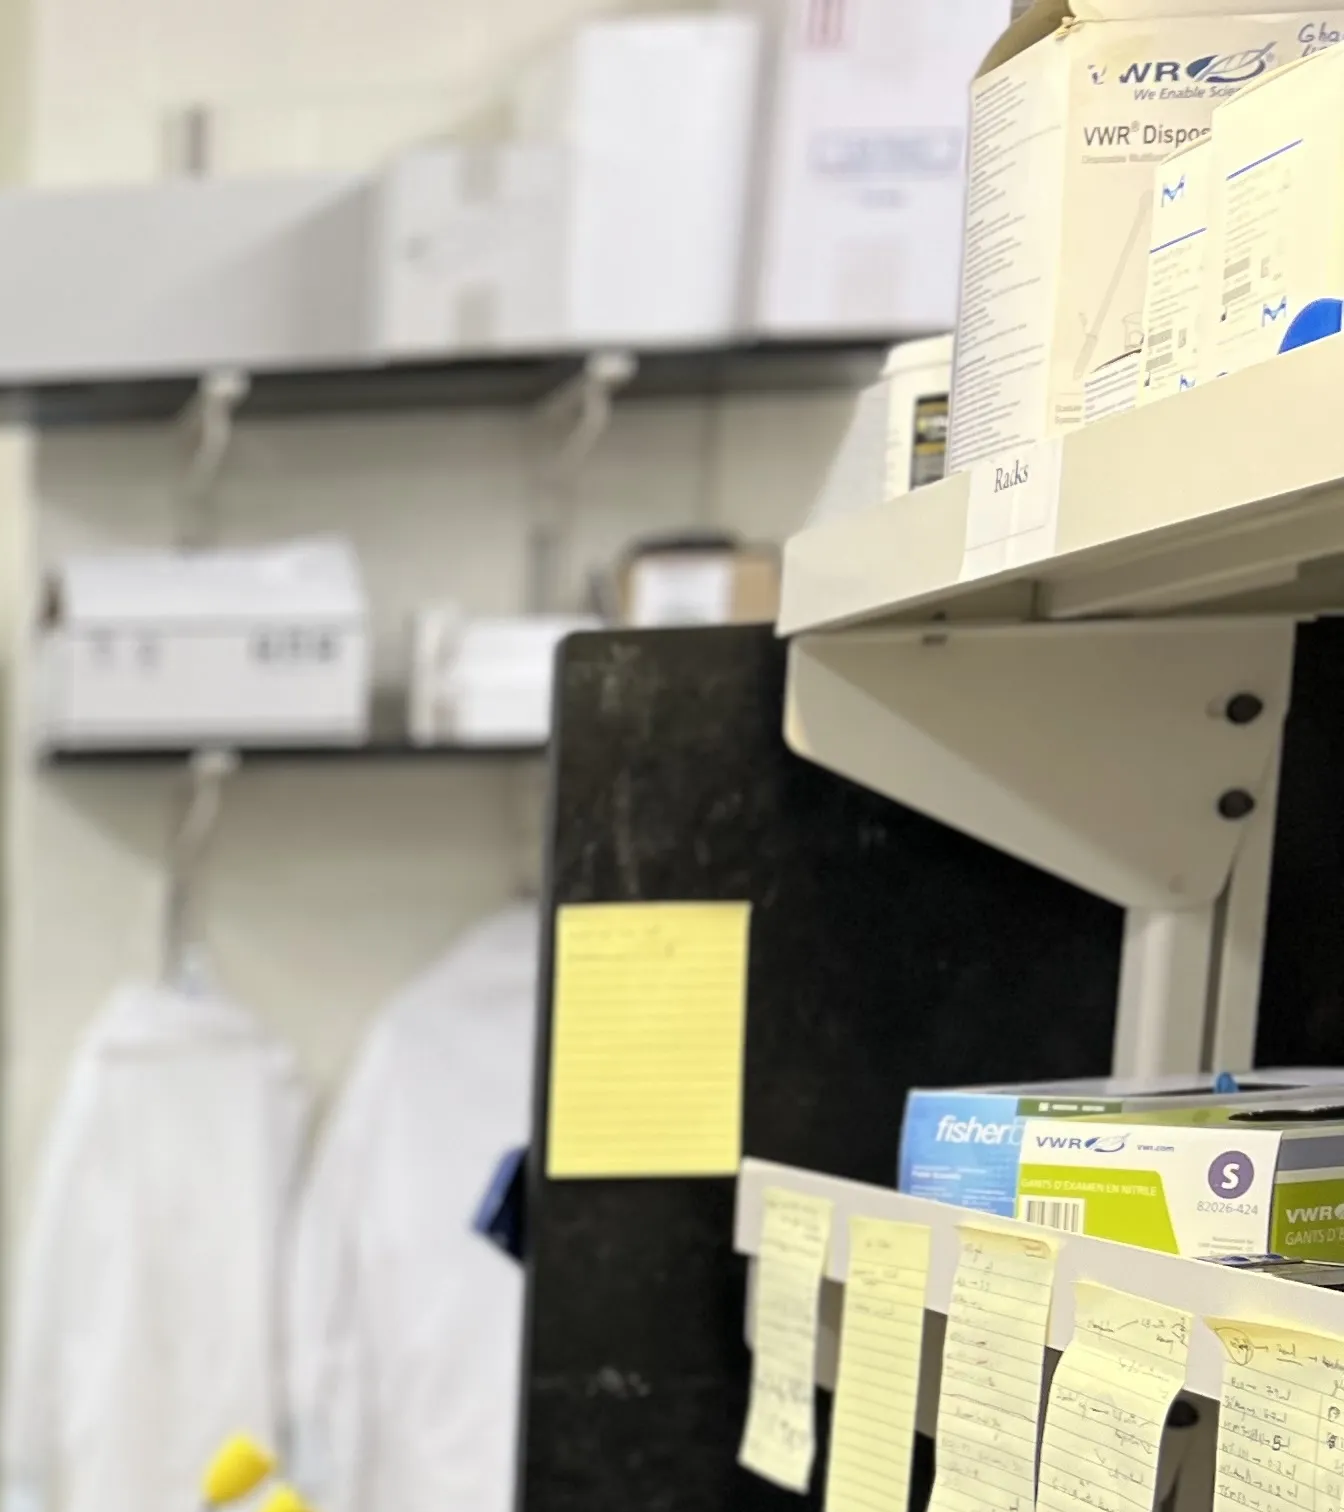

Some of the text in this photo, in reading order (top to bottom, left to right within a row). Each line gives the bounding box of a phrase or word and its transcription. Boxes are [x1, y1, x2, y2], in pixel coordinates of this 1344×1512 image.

[1134, 88, 1155, 100] We
[1159, 86, 1205, 99] Enable
[994, 459, 1028, 493] Racks
[1036, 1136, 1082, 1150] VWR
[1221, 1163, 1240, 1190] S
[1020, 1178, 1052, 1190] GANTS
[1106, 1183, 1120, 1194] EN
[1121, 1184, 1158, 1197] NITRILE
[1196, 1200, 1258, 1215] 82026-424
[1285, 1206, 1333, 1224] VWR
[1284, 1228, 1325, 1246] GANTS
